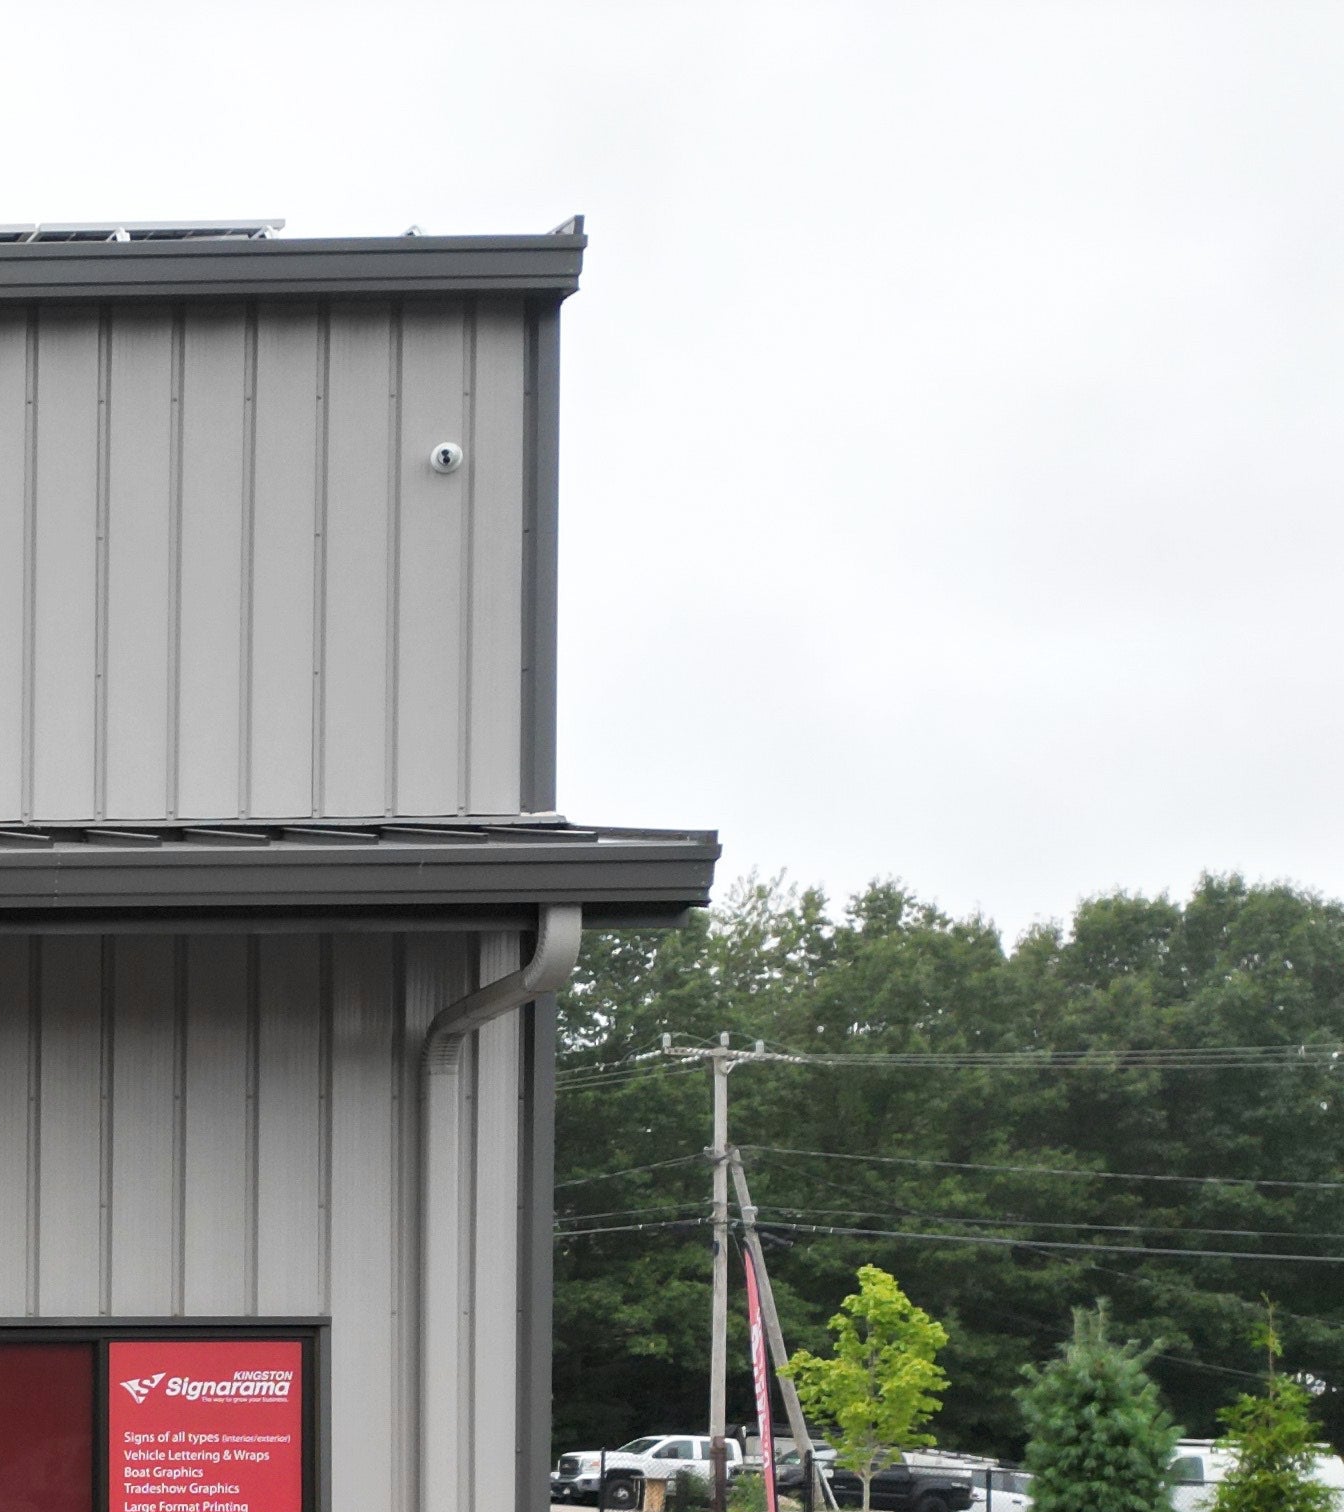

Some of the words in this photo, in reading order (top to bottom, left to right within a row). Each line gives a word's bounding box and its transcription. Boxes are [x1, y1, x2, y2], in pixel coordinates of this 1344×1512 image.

[233, 1370, 293, 1381] KINGSTON
[165, 1376, 291, 1401] Signarama
[124, 1431, 155, 1445] Signs
[157, 1431, 171, 1443] of
[172, 1431, 185, 1443] all
[188, 1433, 219, 1446] types
[124, 1450, 166, 1461] Vehicle
[168, 1450, 220, 1463] Lettering
[223, 1450, 232, 1461] &
[234, 1450, 270, 1463] Wraps
[124, 1467, 150, 1478] Boat
[153, 1467, 203, 1480] Graphics
[124, 1483, 186, 1494] Tradeshow
[189, 1483, 240, 1497] Graphics
[159, 1502, 200, 1512] Format
